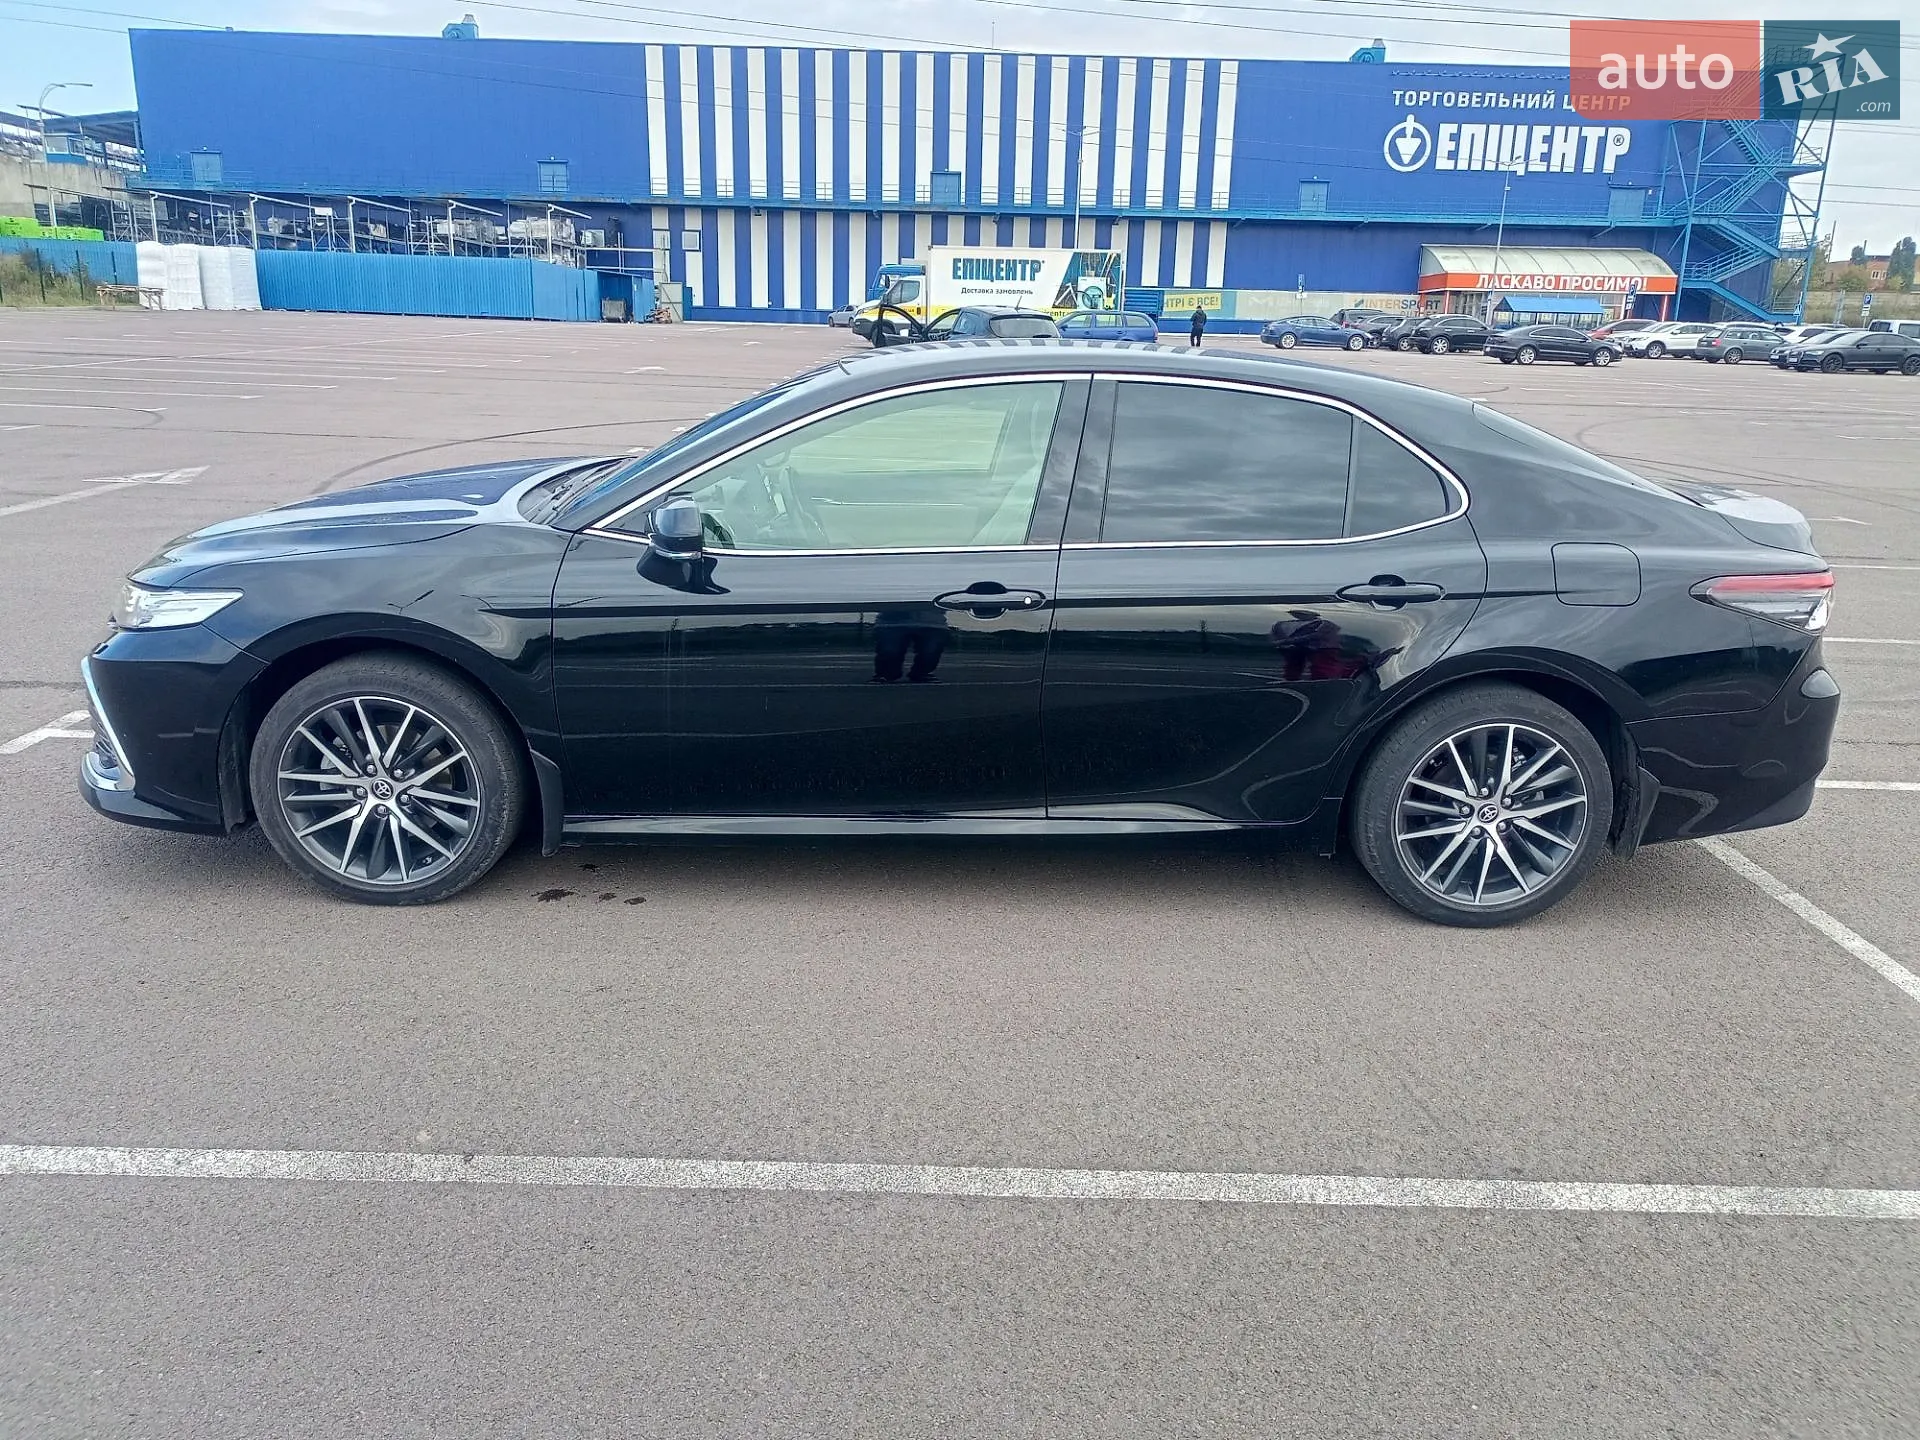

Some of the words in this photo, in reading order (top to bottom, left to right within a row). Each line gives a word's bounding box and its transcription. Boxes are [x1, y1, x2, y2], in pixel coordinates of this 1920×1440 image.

[1392, 89, 1557, 110] ТОРГОВЕЛЬНИЙ
[1562, 94, 1632, 113] ЦЕНТР
[1476, 273, 1555, 291] ЛАСКАВО
[1558, 275, 1648, 292] ПРОСИМО!
[960, 286, 994, 295] Доставка
[1187, 297, 1195, 307] Є
